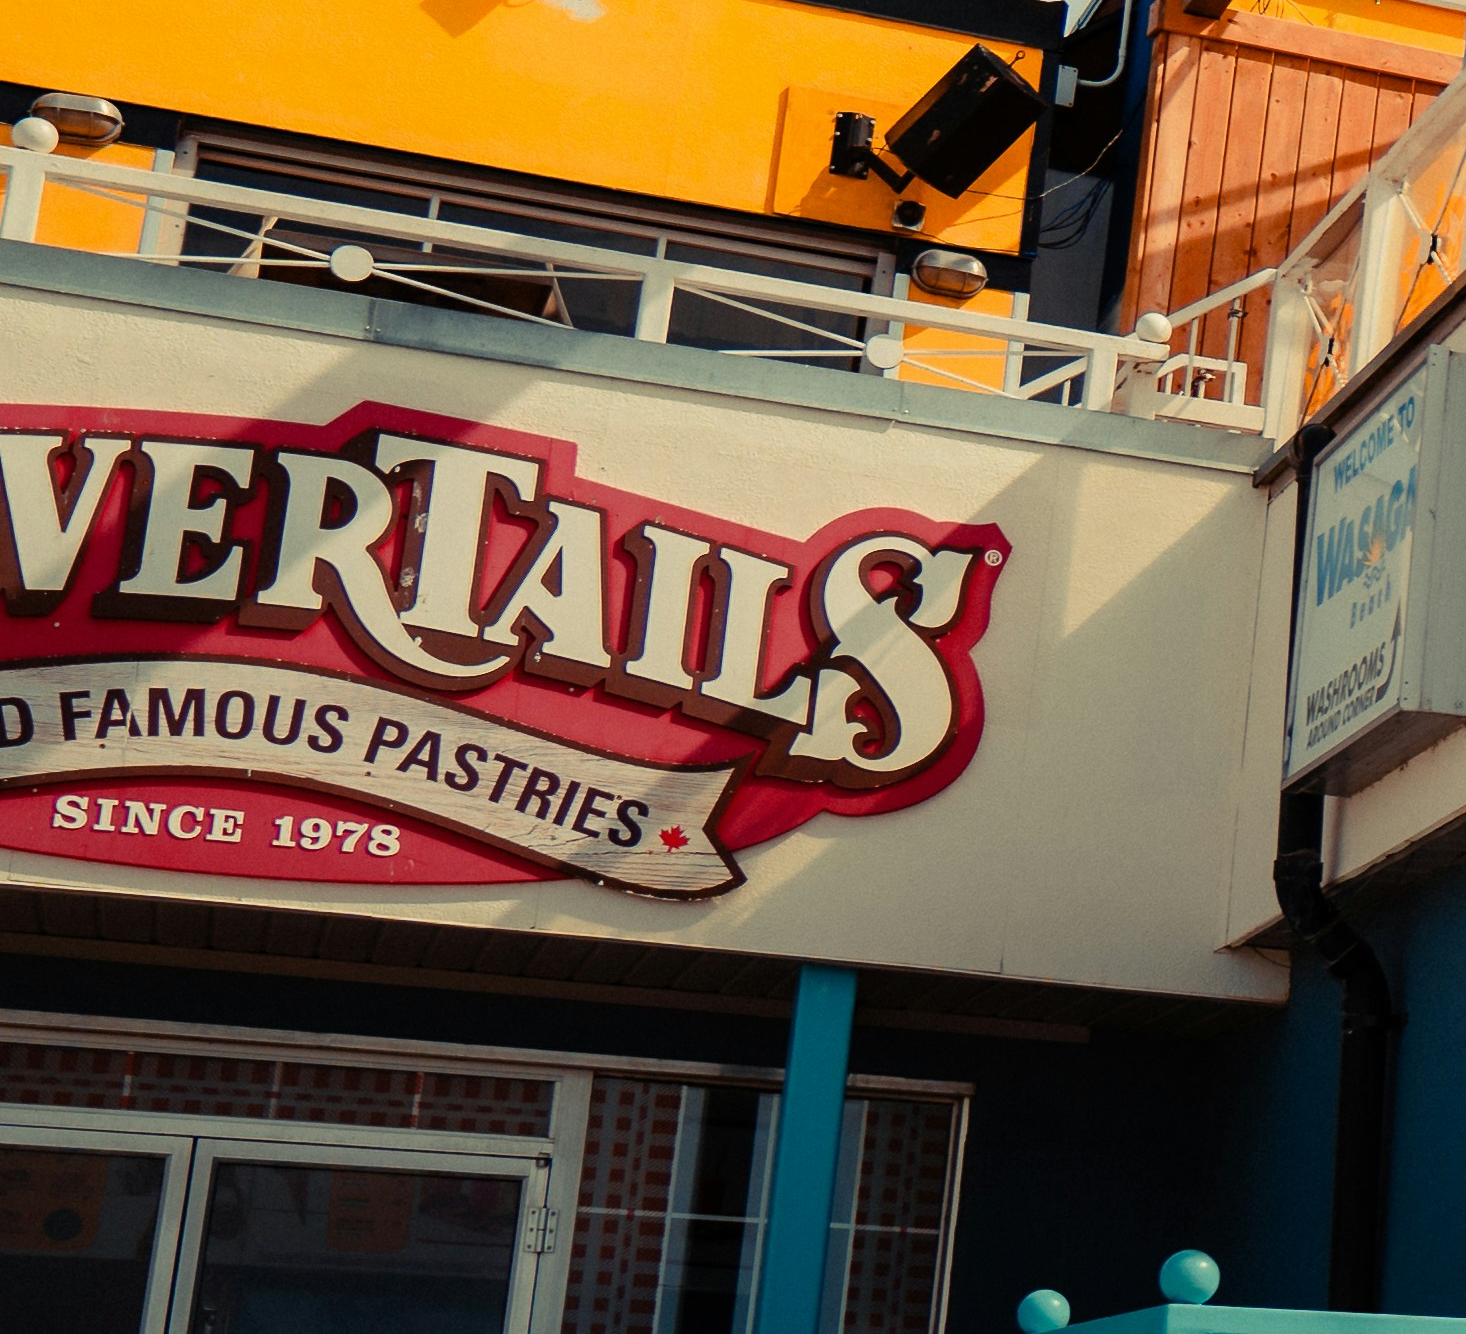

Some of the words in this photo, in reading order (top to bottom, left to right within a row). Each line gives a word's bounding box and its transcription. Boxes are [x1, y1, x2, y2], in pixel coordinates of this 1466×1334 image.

[1333, 419, 1395, 495] WELCOME
[1398, 396, 1416, 434] TO
[1306, 641, 1386, 727] WASHROOMS
[1306, 711, 1341, 750] AROUND
[1342, 686, 1375, 730] CORNER
[58, 687, 350, 755] FAMOUS
[363, 716, 651, 849] PASTRIES
[52, 794, 245, 844] SINCE
[271, 814, 401, 858] 1978
